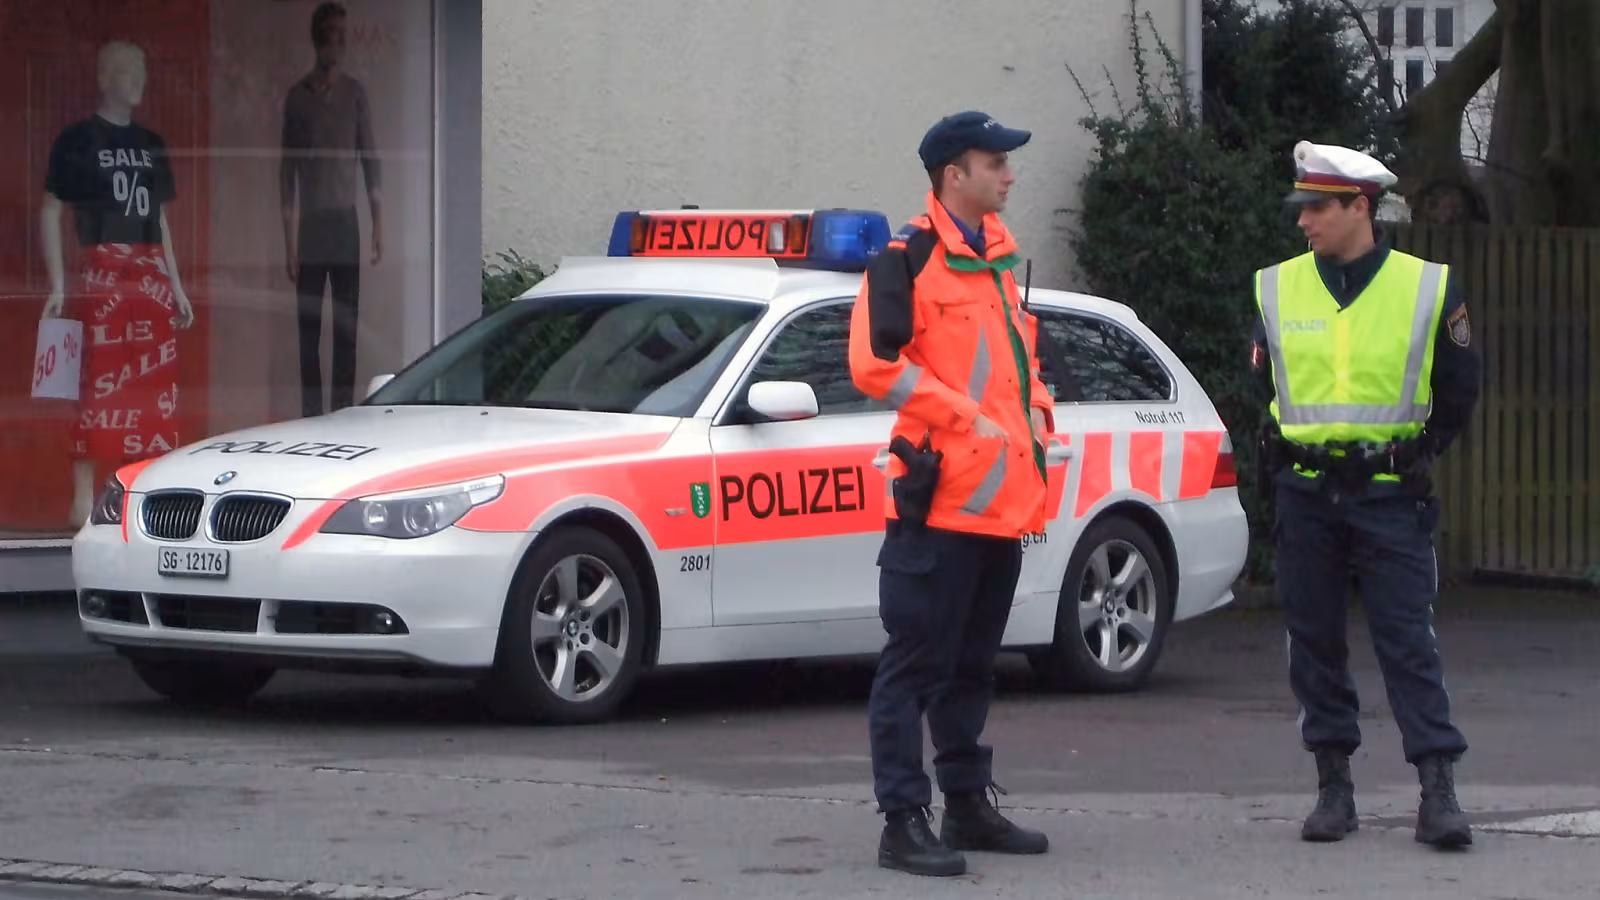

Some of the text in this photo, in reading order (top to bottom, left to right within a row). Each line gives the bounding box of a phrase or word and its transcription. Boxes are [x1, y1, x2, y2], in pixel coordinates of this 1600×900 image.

[98, 149, 152, 168] SALE
[35, 344, 57, 388] 50
[94, 338, 177, 399] SALE
[79, 409, 142, 430] SALE
[1134, 410, 1186, 424] Notruf 117
[187, 440, 381, 461] POLIZEI
[719, 465, 866, 522] POLIZEI
[679, 554, 712, 572] 2801
